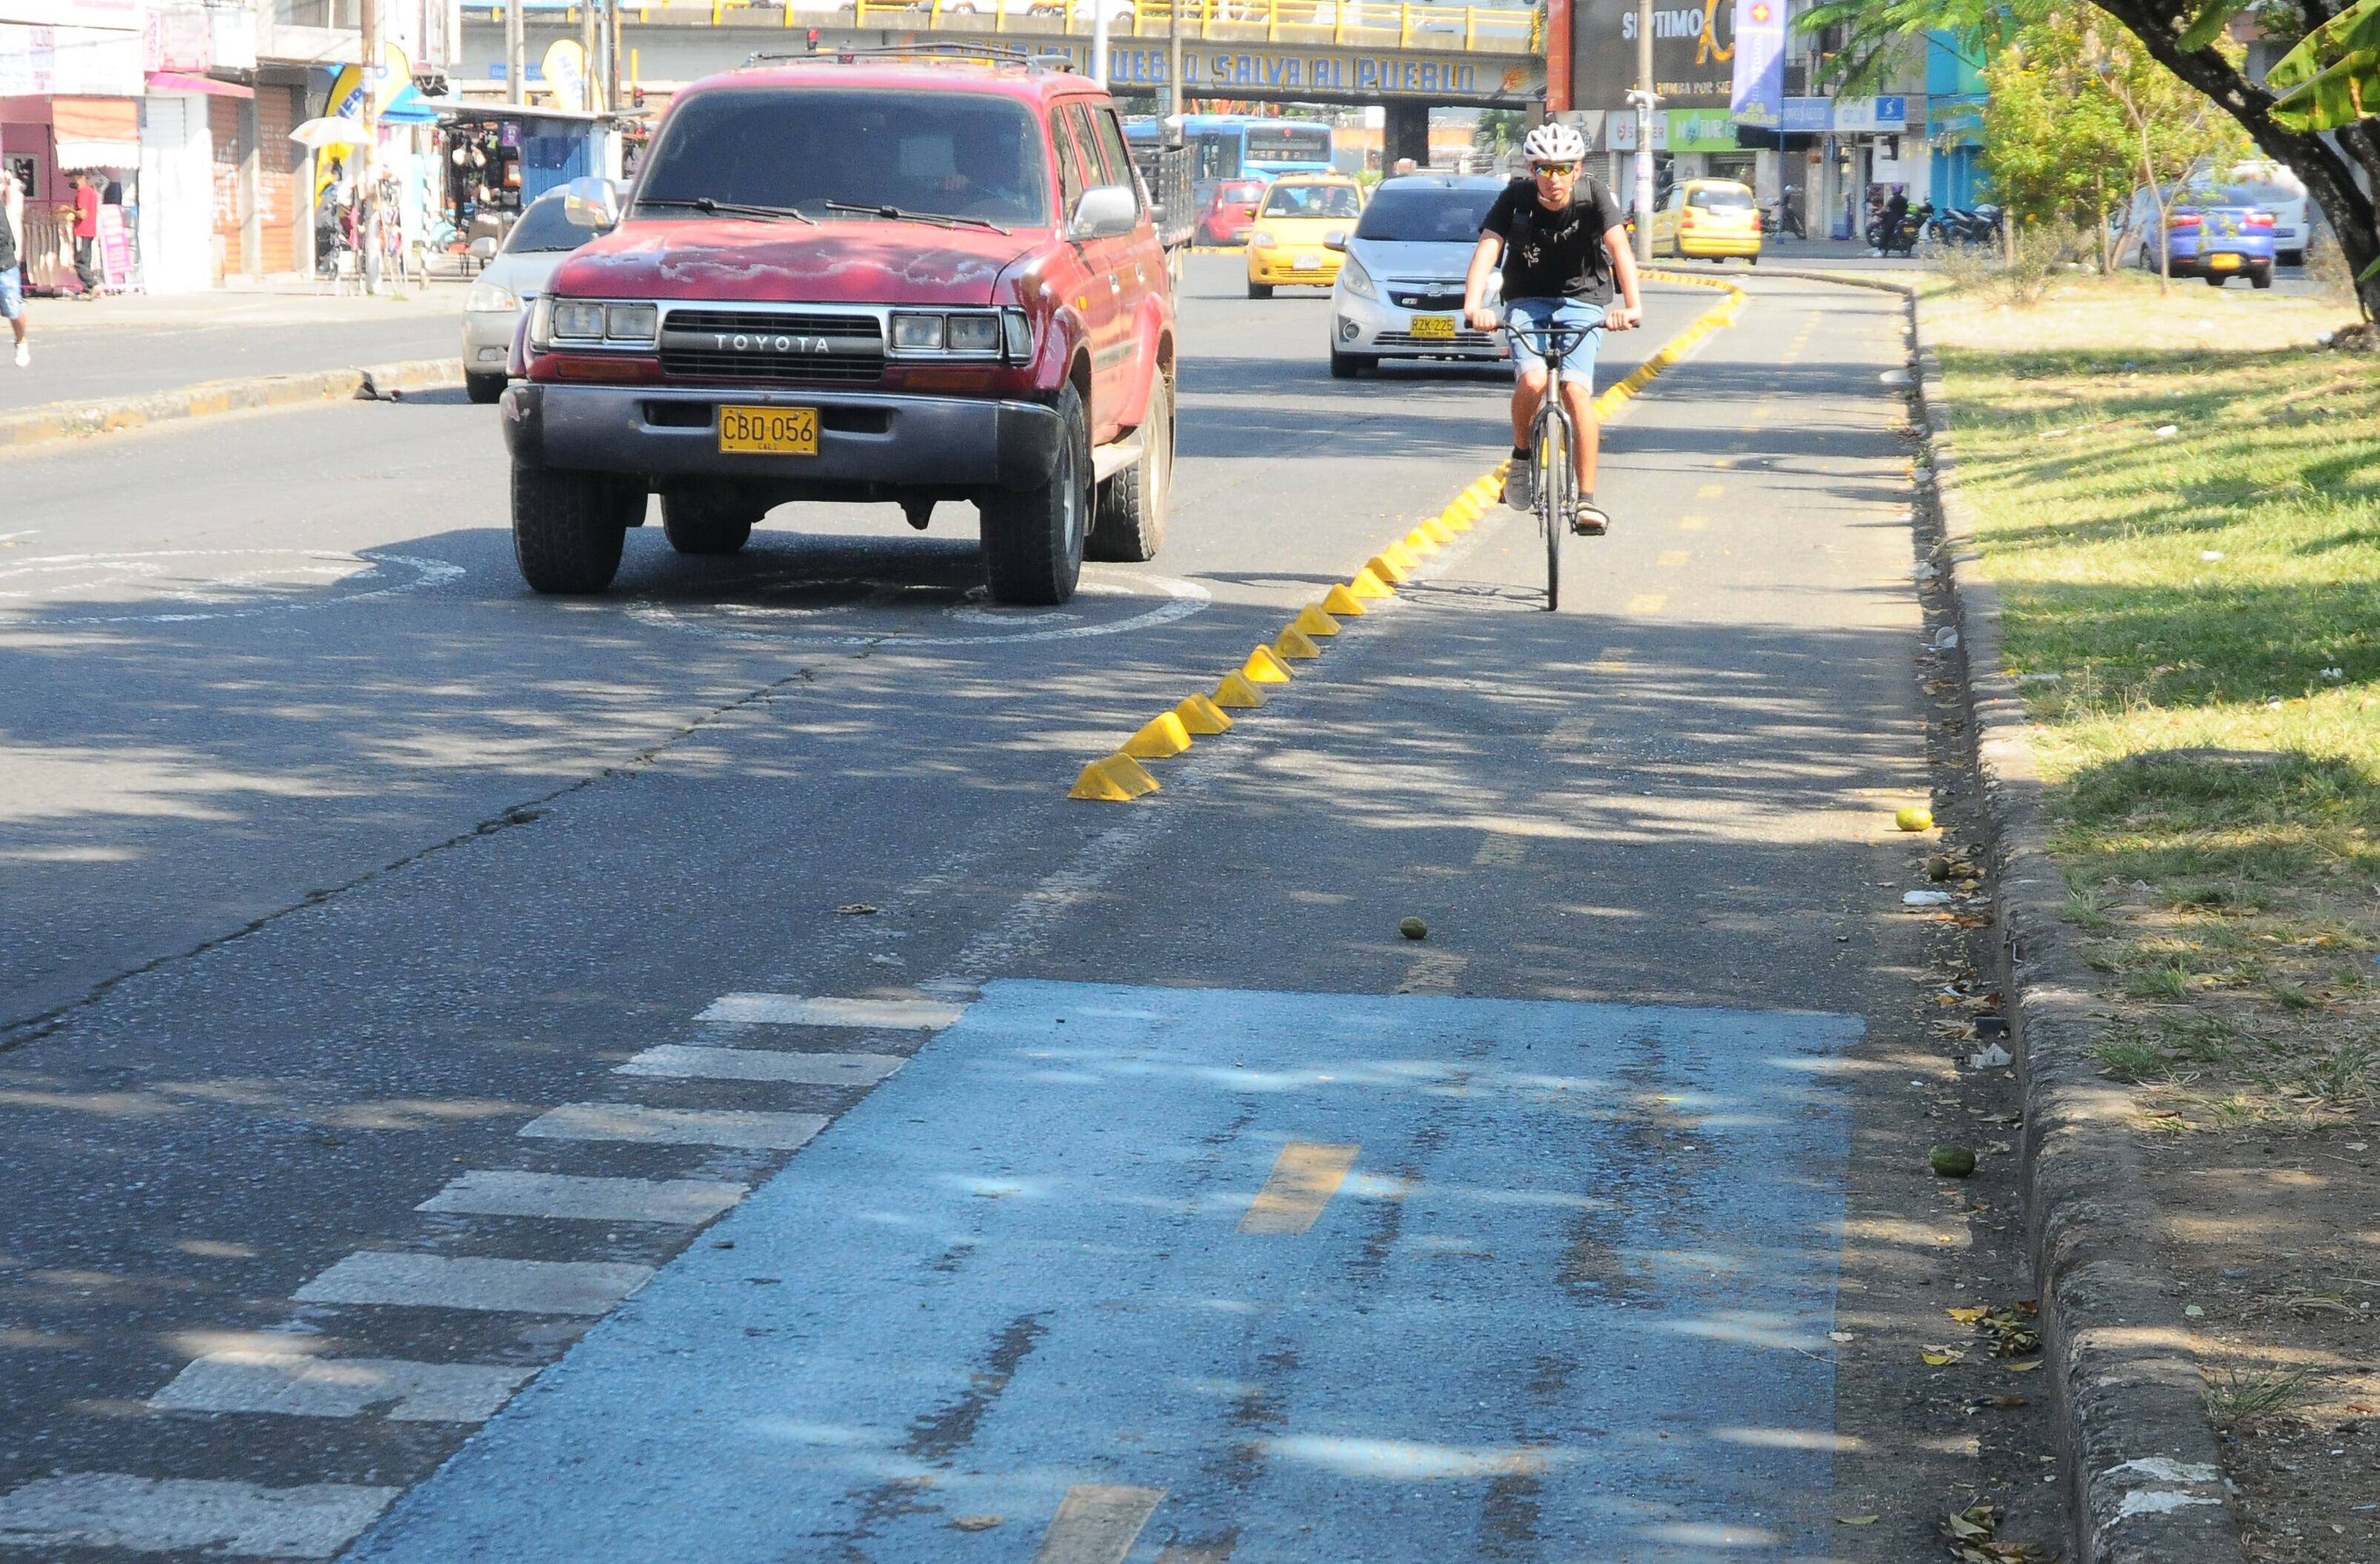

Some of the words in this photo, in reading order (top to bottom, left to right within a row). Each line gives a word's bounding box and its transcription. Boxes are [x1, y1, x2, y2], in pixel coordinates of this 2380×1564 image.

[1622, 8, 1704, 39] STIMO
[1088, 49, 1199, 83] UEBO
[1215, 53, 1302, 87] SALVA
[1314, 57, 1342, 87] AL
[1357, 57, 1476, 93] PUEBLO
[1694, 81, 1713, 95] POR
[715, 334, 829, 353] TOYOTA
